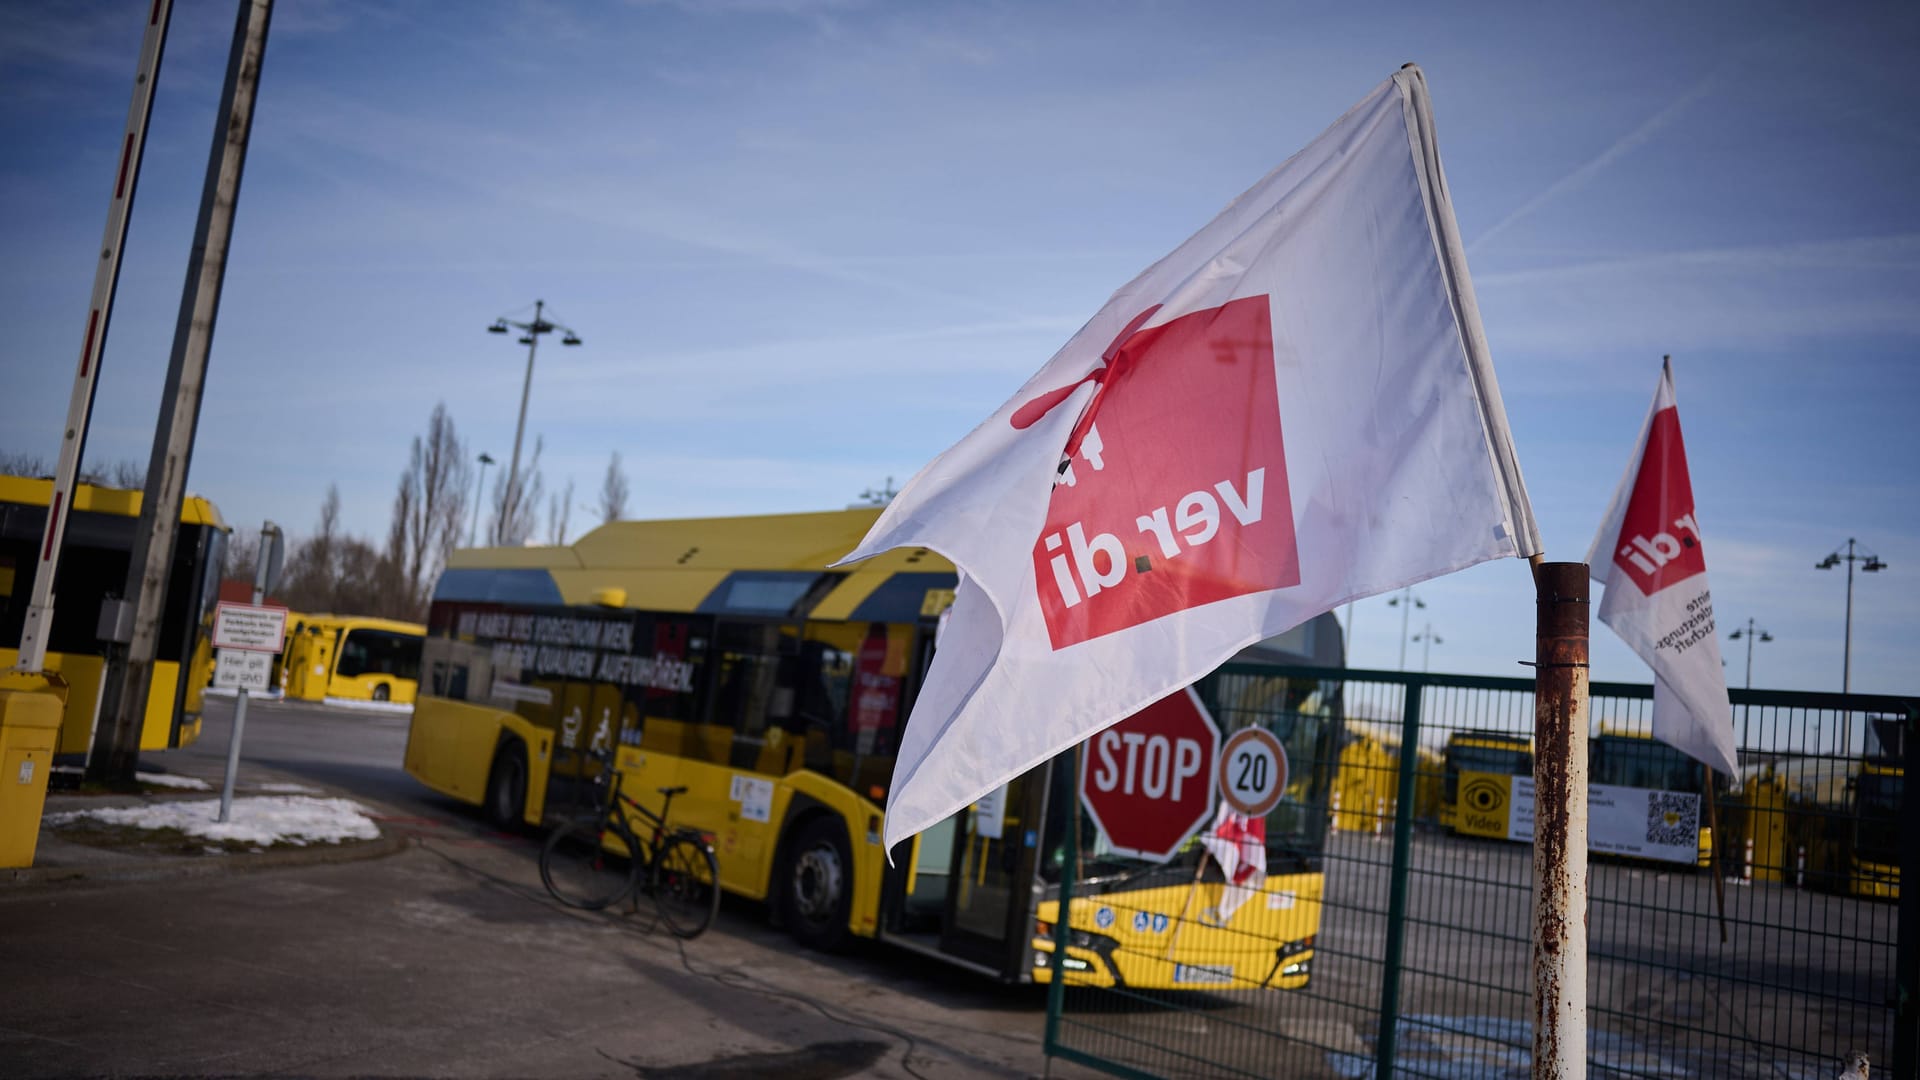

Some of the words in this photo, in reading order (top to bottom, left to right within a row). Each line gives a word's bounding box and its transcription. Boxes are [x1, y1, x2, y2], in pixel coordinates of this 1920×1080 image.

[1094, 730, 1202, 802] STOP
[1237, 752, 1268, 793] 20
[1465, 814, 1502, 832] Video
